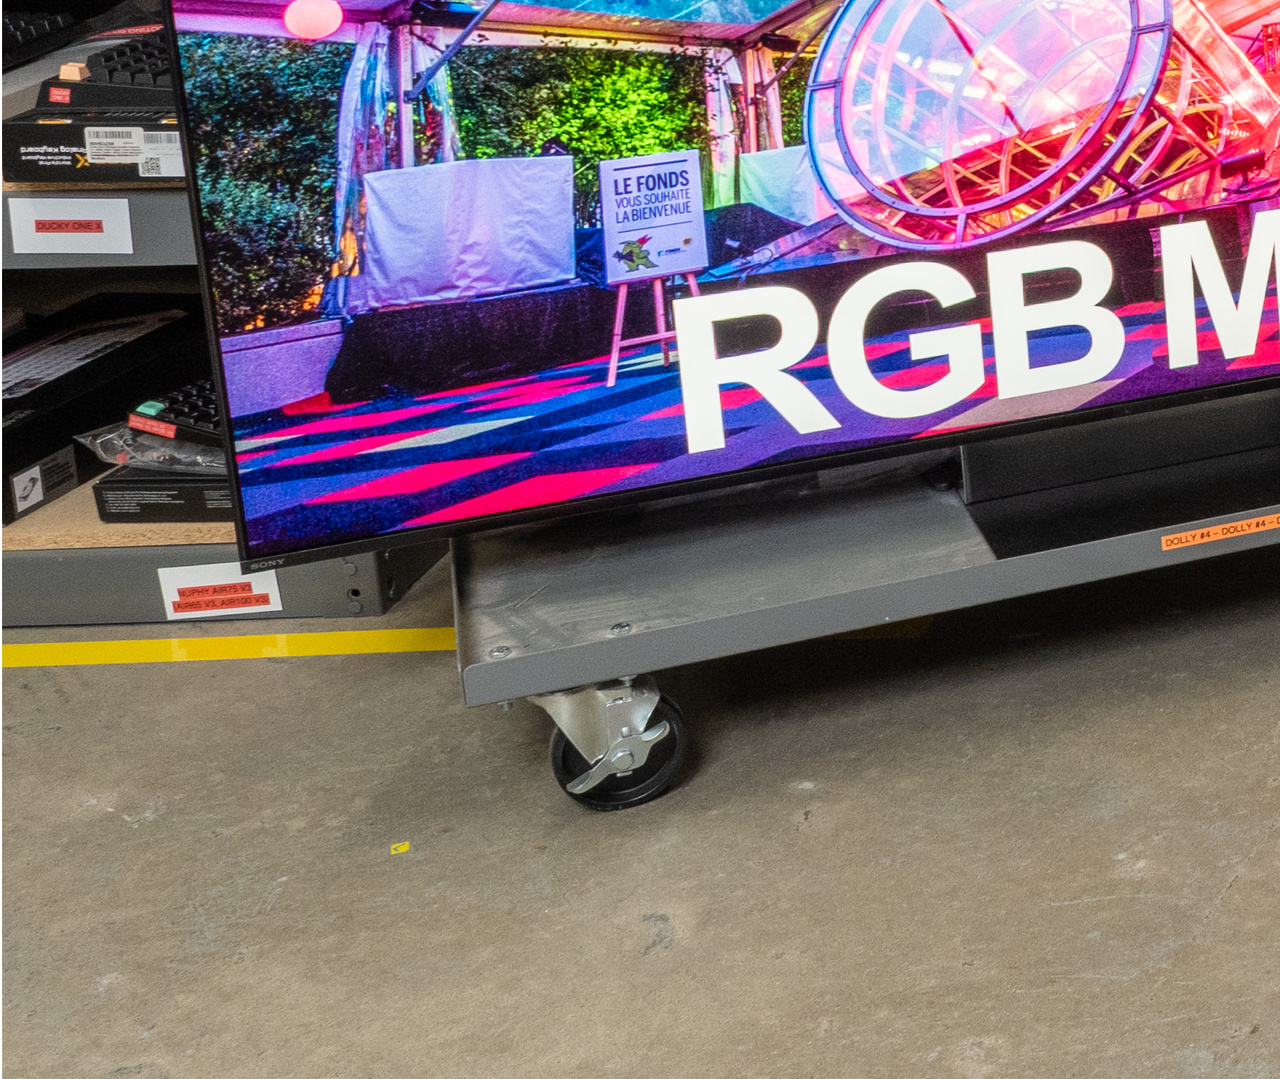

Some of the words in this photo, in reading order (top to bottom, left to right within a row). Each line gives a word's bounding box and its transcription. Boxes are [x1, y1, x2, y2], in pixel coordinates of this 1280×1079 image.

[20, 145, 55, 154] Keyboard
[614, 177, 632, 195] LE
[636, 170, 690, 192] FONDS
[615, 195, 644, 209] VOUS
[644, 188, 691, 206] SOUHAITE
[615, 209, 630, 223] LA
[631, 201, 692, 221] BIENVENUE
[37, 221, 70, 230] DUCKY
[72, 221, 93, 230] ONE
[673, 241, 1125, 453] RGB
[1165, 534, 1197, 547] DOLLY
[1200, 530, 1211, 539] #4
[1221, 523, 1253, 536] DOLLY
[1255, 520, 1266, 529] #4
[251, 559, 285, 570] SONY
[212, 586, 238, 594] AIR75
